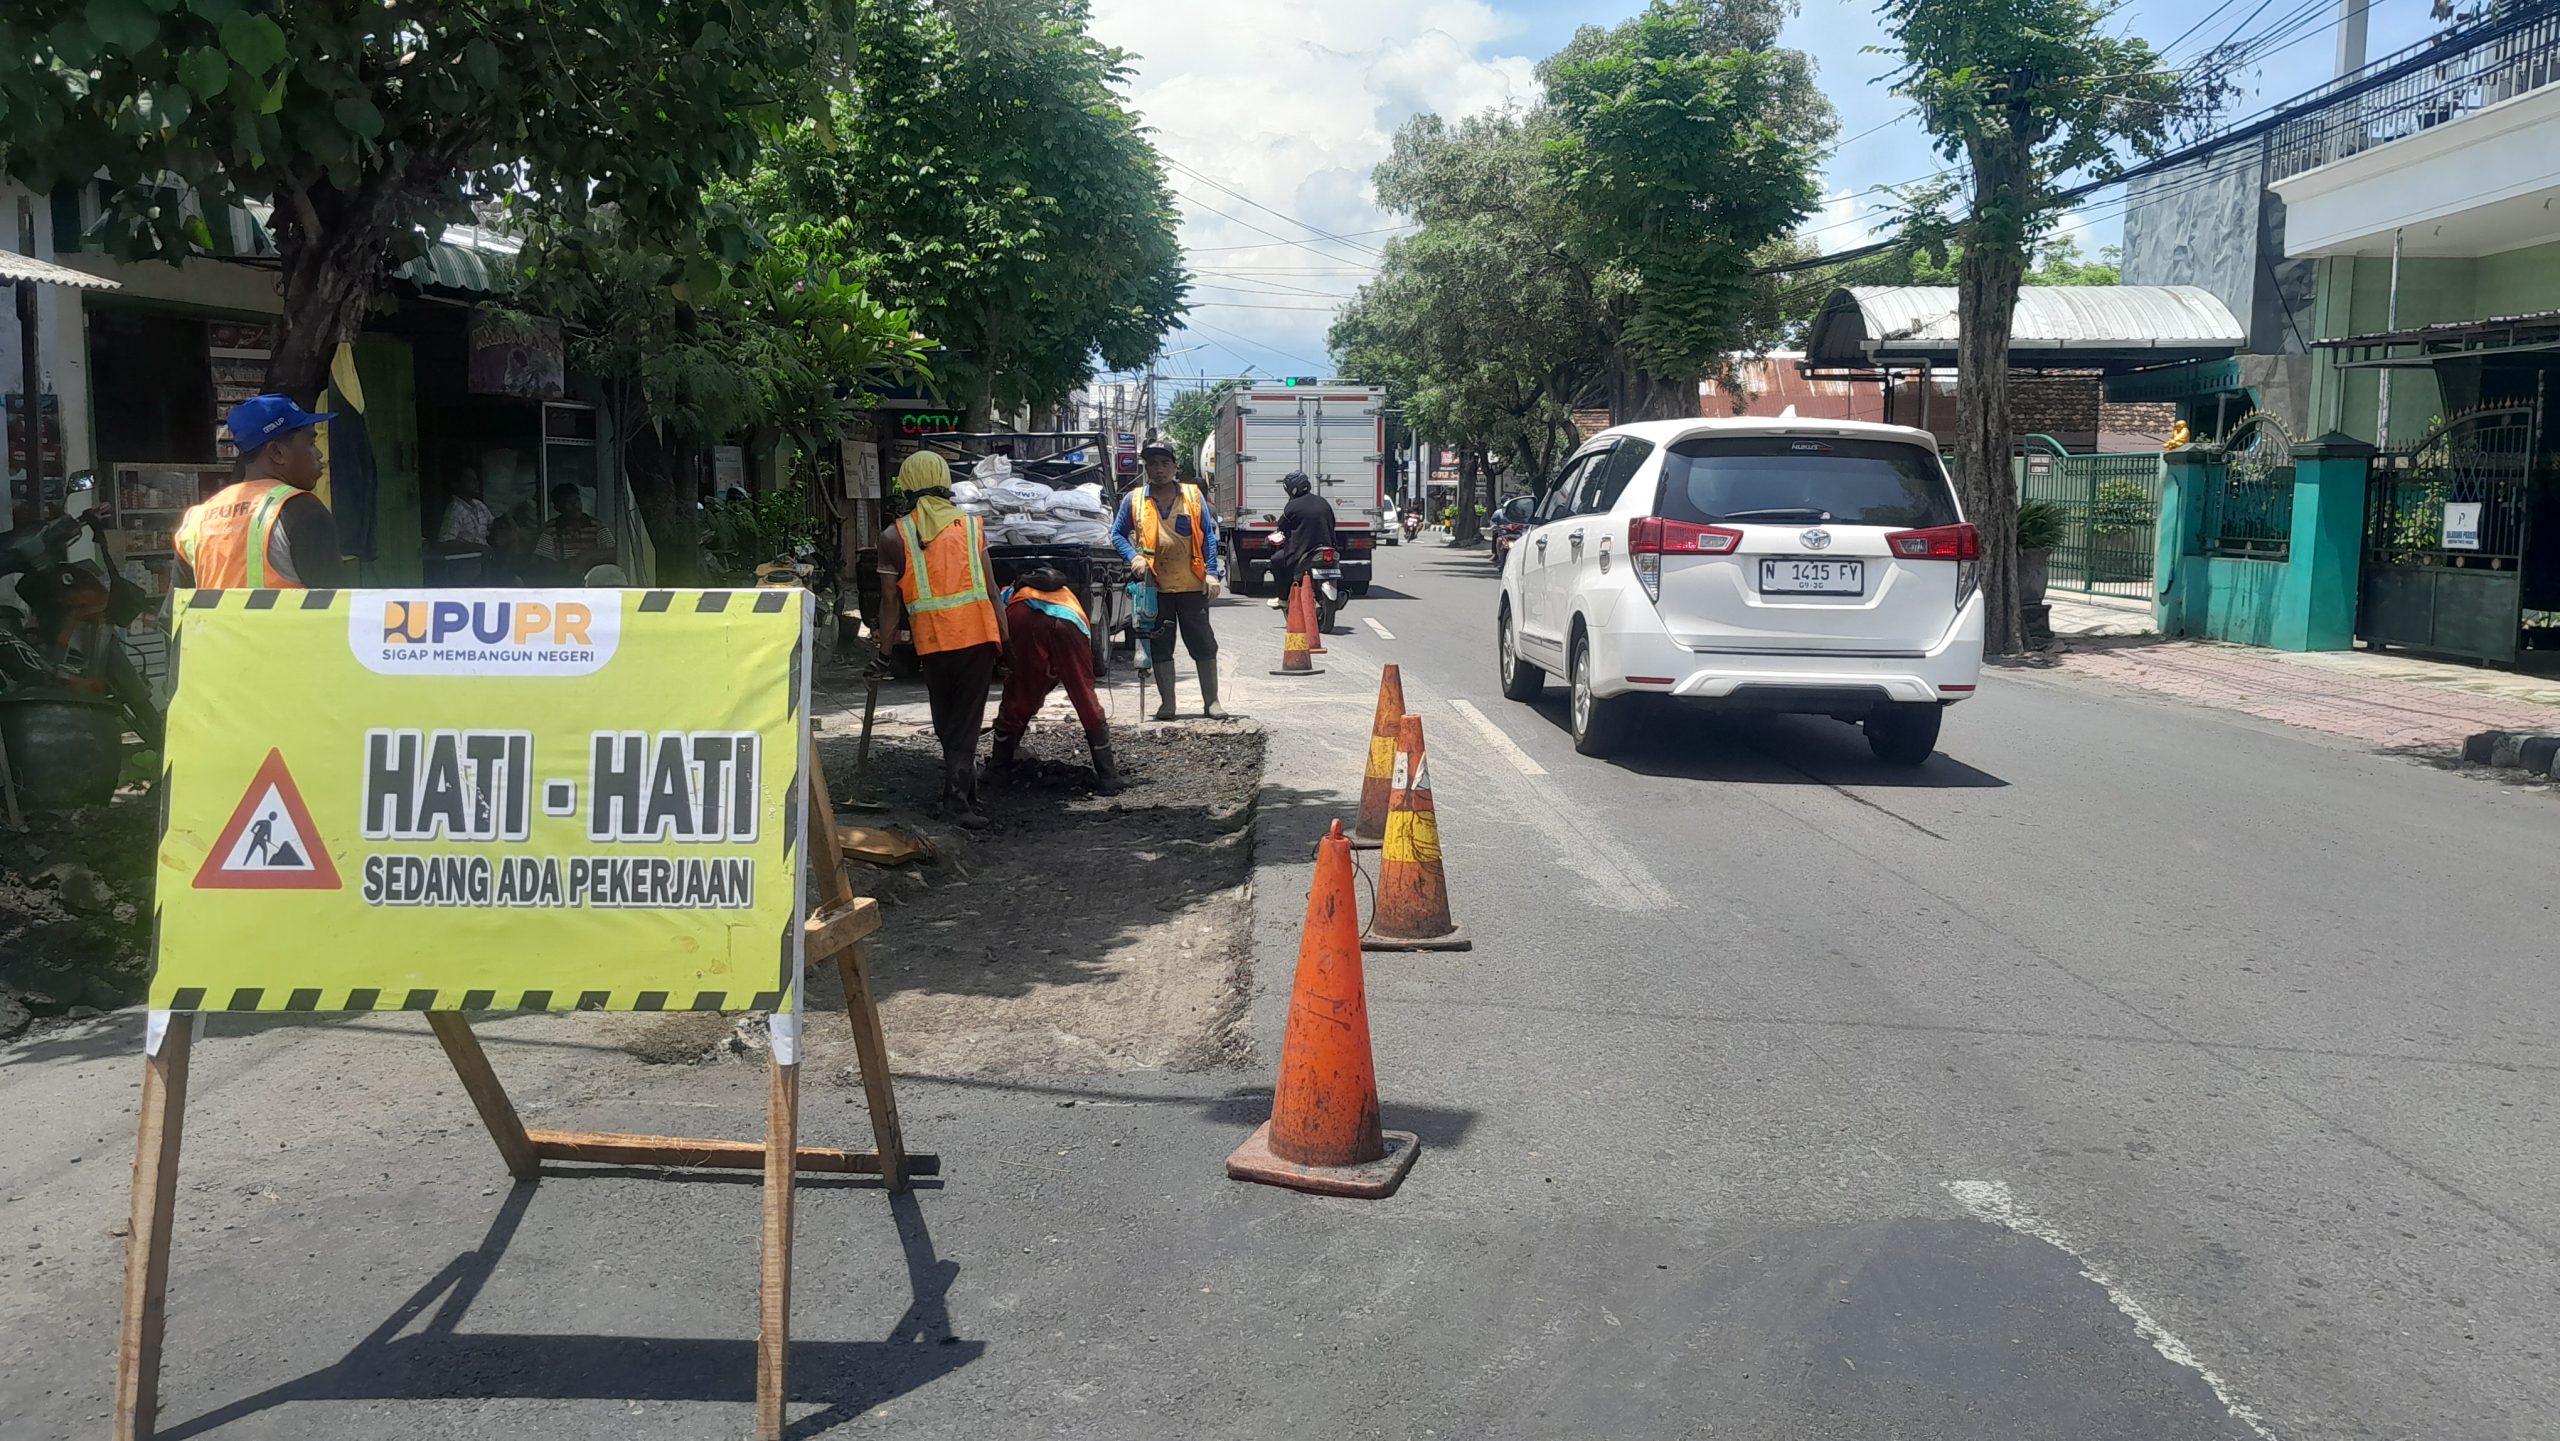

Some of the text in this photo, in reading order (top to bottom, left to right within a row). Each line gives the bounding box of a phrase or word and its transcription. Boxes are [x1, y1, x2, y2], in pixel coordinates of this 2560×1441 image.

[902, 414, 959, 433] CCTV
[1766, 563, 1858, 582] N 1415 FY
[432, 601, 593, 645] PUPR
[382, 649, 595, 662] SIGAP MEMBANGUN NEGERI
[365, 733, 530, 834] HATI
[592, 735, 756, 836] HATI
[364, 856, 751, 906] SEDANG ADA PEKERJAAN
